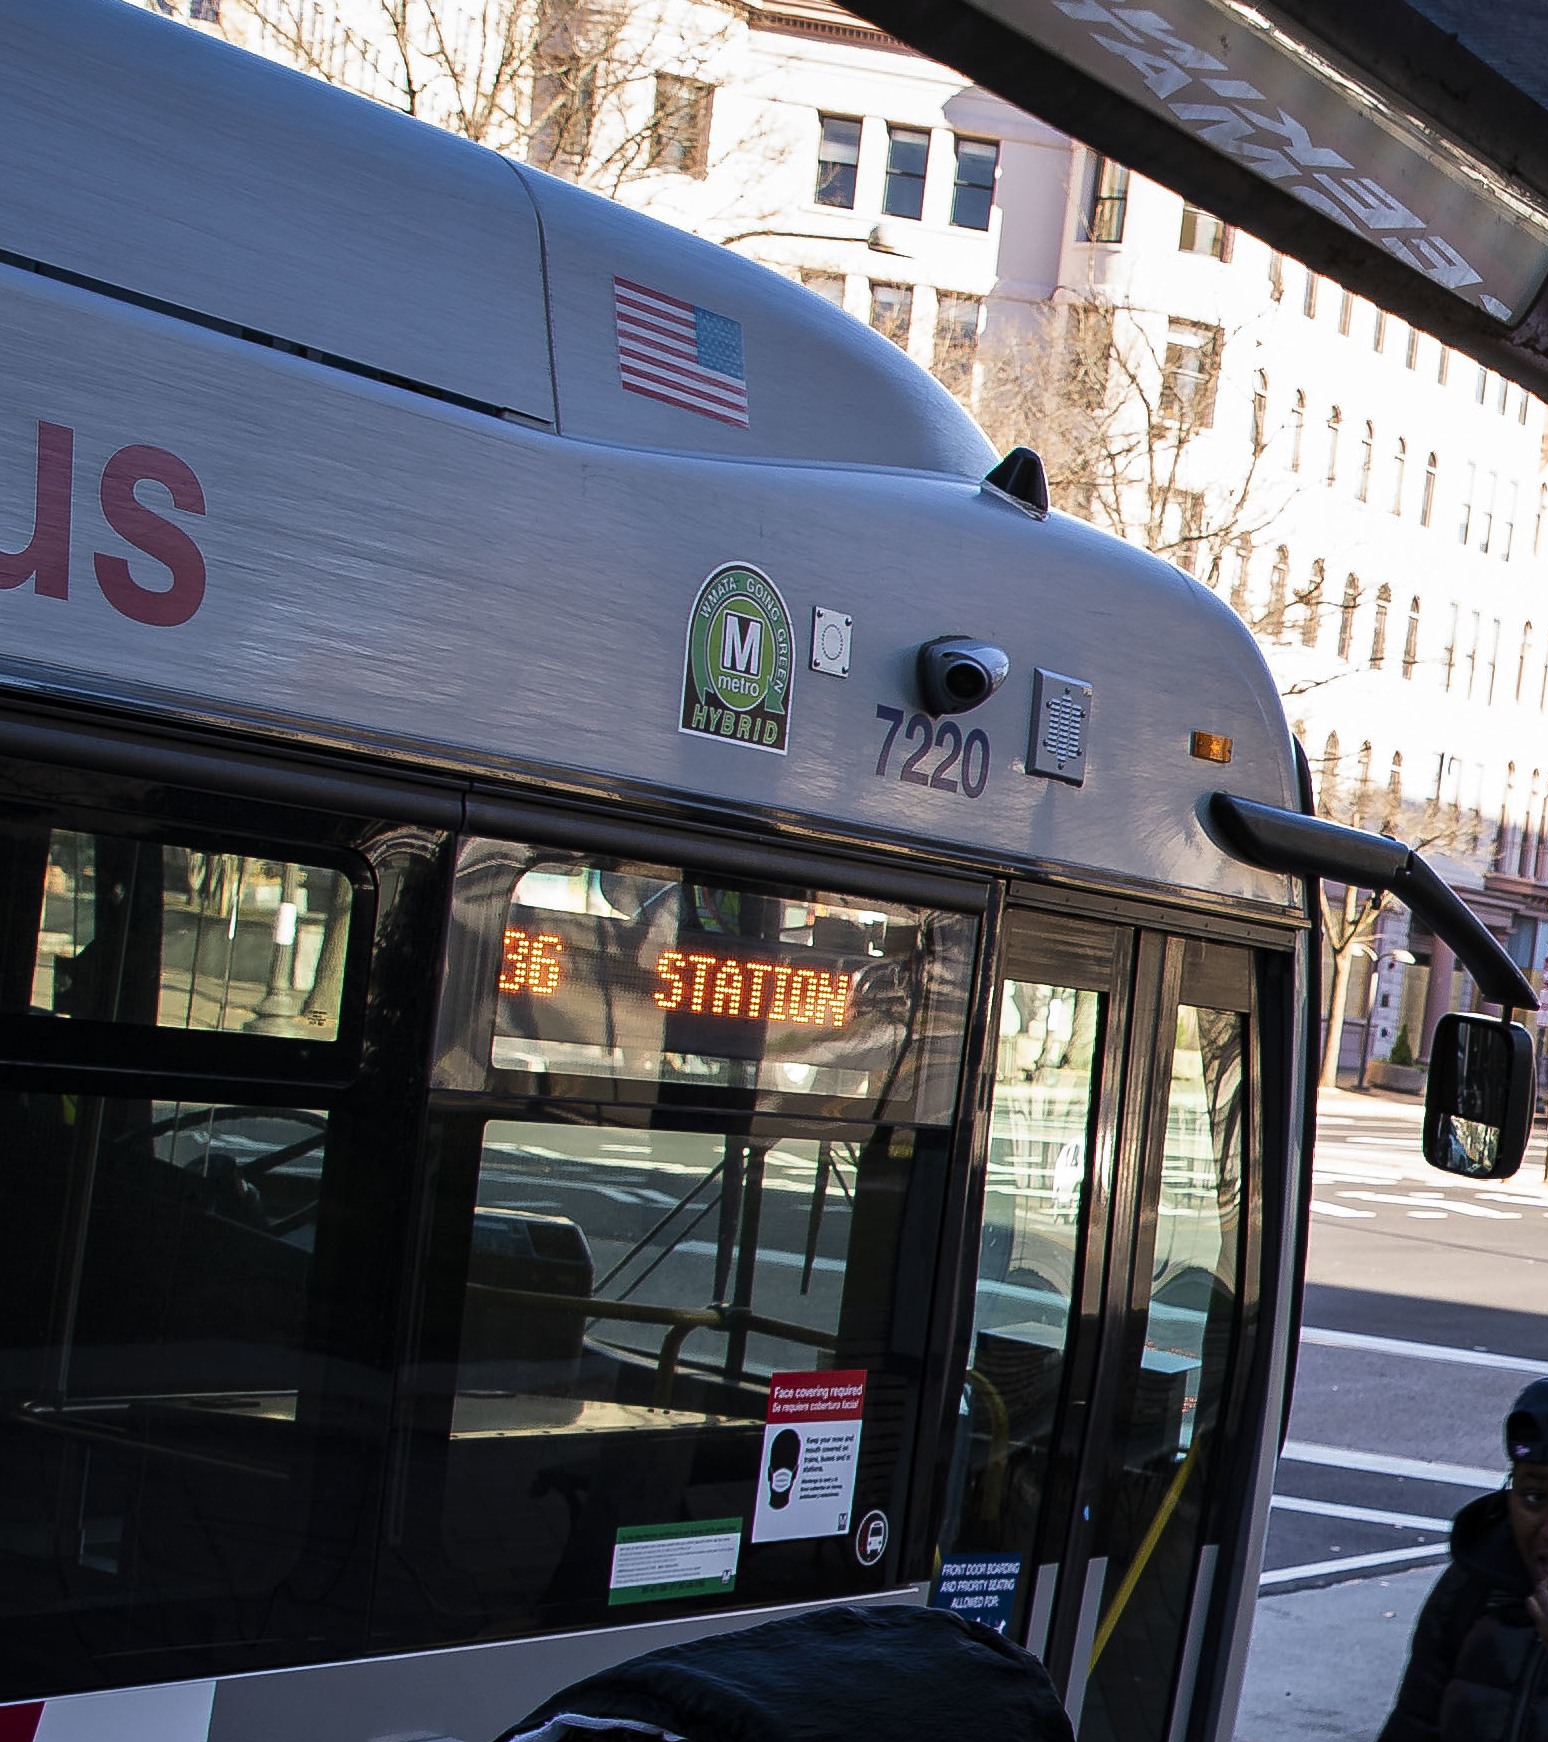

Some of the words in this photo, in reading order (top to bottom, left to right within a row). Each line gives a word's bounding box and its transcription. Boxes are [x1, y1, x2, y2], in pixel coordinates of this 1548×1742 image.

[700, 577, 737, 618] WMATA
[746, 578, 780, 622] GOING
[776, 628, 787, 694] GREEN
[724, 615, 762, 675] M
[717, 675, 759, 697] metro
[692, 703, 778, 744] HYBRID
[875, 703, 990, 799] 7220
[653, 950, 850, 1028] STATION
[830, 1383, 863, 1399] required
[942, 1563, 965, 1576] FRONT
[966, 1563, 986, 1576] DOOR
[986, 1562, 1021, 1576] BOARDING
[940, 1580, 957, 1593] AND
[958, 1579, 987, 1592] PRIORITY
[987, 1578, 1015, 1591] SEATING
[950, 1596, 983, 1609] ALLOWED
